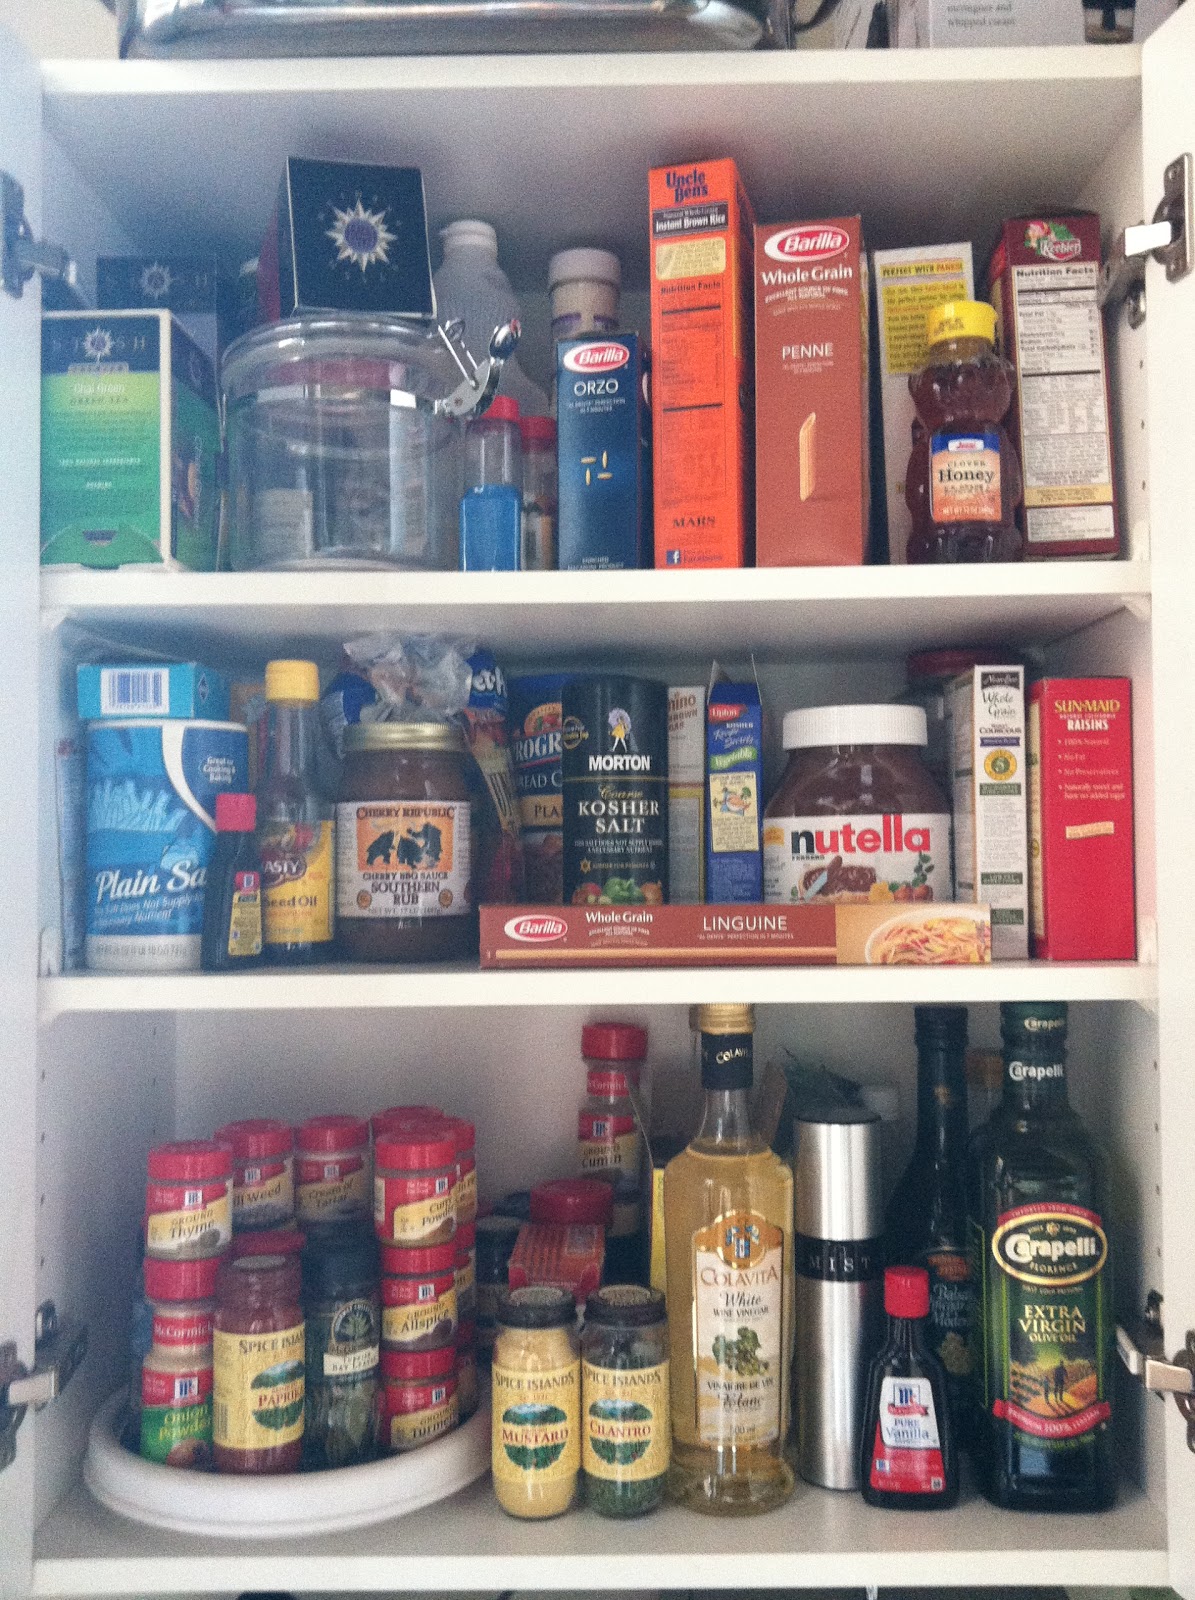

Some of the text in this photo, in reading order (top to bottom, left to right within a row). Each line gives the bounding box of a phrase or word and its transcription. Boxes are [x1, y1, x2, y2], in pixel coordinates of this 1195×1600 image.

[666, 168, 705, 188] Uncle
[656, 213, 726, 232] Instant Brown Rice
[784, 231, 842, 253] Barilla
[1040, 238, 1082, 256] Keebler
[762, 263, 853, 286] Whole Grain
[1017, 266, 1094, 278] Nutrition Facts
[579, 347, 624, 365] Barilla
[782, 342, 834, 360] PENNE
[574, 378, 619, 397] ORZO
[948, 460, 986, 468] CLOVER
[938, 468, 995, 484] Honey
[712, 708, 739, 718] Lipton
[1067, 719, 1109, 732] RAISINS
[207, 756, 227, 767] Great
[589, 754, 650, 772] MORTON
[715, 749, 753, 768] Vegetable
[356, 805, 455, 819] CHERRY REPUBLIC
[579, 799, 660, 816] KOSHER
[595, 817, 645, 834] SALT
[791, 813, 931, 854] nutella
[264, 858, 300, 874] ASTY
[95, 860, 207, 903] Plain Sa
[362, 871, 398, 881] CHERRY
[420, 871, 448, 880] SAUCE
[371, 881, 440, 895] SOUTHERN
[298, 894, 317, 907] Oil
[393, 895, 419, 906] RUB
[585, 910, 654, 924] Whole Grain
[703, 915, 788, 932] LINGUINE
[518, 920, 563, 935] Barilla
[1008, 1060, 1064, 1082] Carapelli
[247, 1182, 282, 1203] Weed
[171, 1208, 214, 1227] GROUND
[170, 1219, 216, 1239] Thyme
[1004, 1232, 1096, 1264] Carapelli
[809, 1255, 871, 1273] MIST
[1029, 1261, 1079, 1275] FLORENCE
[700, 1265, 779, 1287] COLAVITA
[719, 1290, 762, 1308] White
[713, 1305, 769, 1318] WINE VINEGAR
[1024, 1304, 1083, 1320] EXTRA
[400, 1309, 449, 1335] Allspice
[1018, 1318, 1087, 1334] VIRGIN
[238, 1339, 279, 1354] SPICE
[1028, 1333, 1059, 1343] OLIVE
[495, 1370, 575, 1391] SPICE ISLANDS
[612, 1370, 662, 1388] ISLANDS
[164, 1404, 208, 1426] Onion
[894, 1418, 920, 1427] PURE
[501, 1428, 569, 1445] MUSTARD
[589, 1419, 651, 1438] CILANTRO
[885, 1426, 930, 1440] Vanilla
